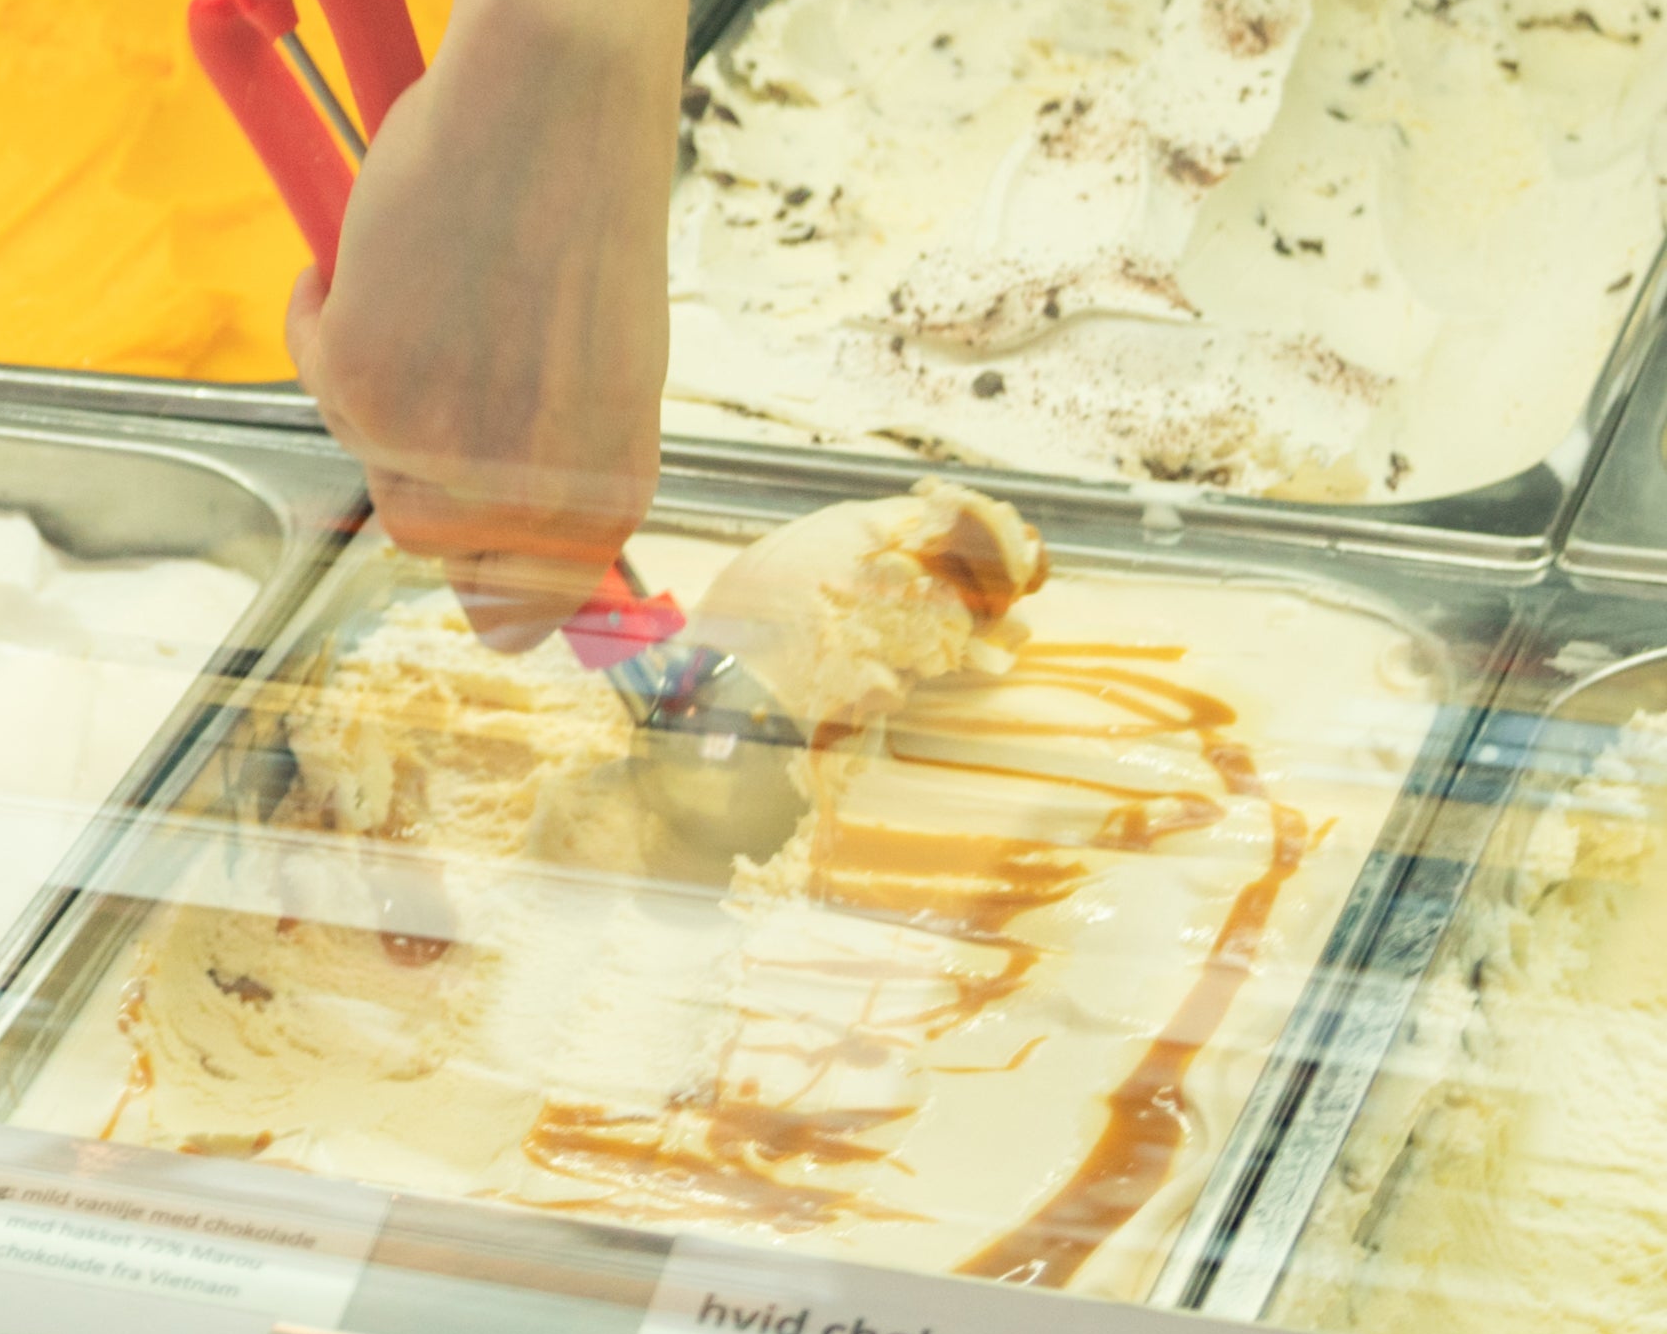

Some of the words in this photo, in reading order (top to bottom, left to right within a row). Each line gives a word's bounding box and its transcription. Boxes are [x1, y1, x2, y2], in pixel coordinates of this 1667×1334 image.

[5, 1212, 57, 1236] med
[58, 1221, 135, 1250] hakket
[20, 1185, 73, 1208] mild
[74, 1194, 147, 1222] vanilje
[149, 1207, 200, 1230] med
[203, 1215, 319, 1252] chokolade
[110, 1260, 144, 1284] fra
[149, 1269, 243, 1300] Vietnam
